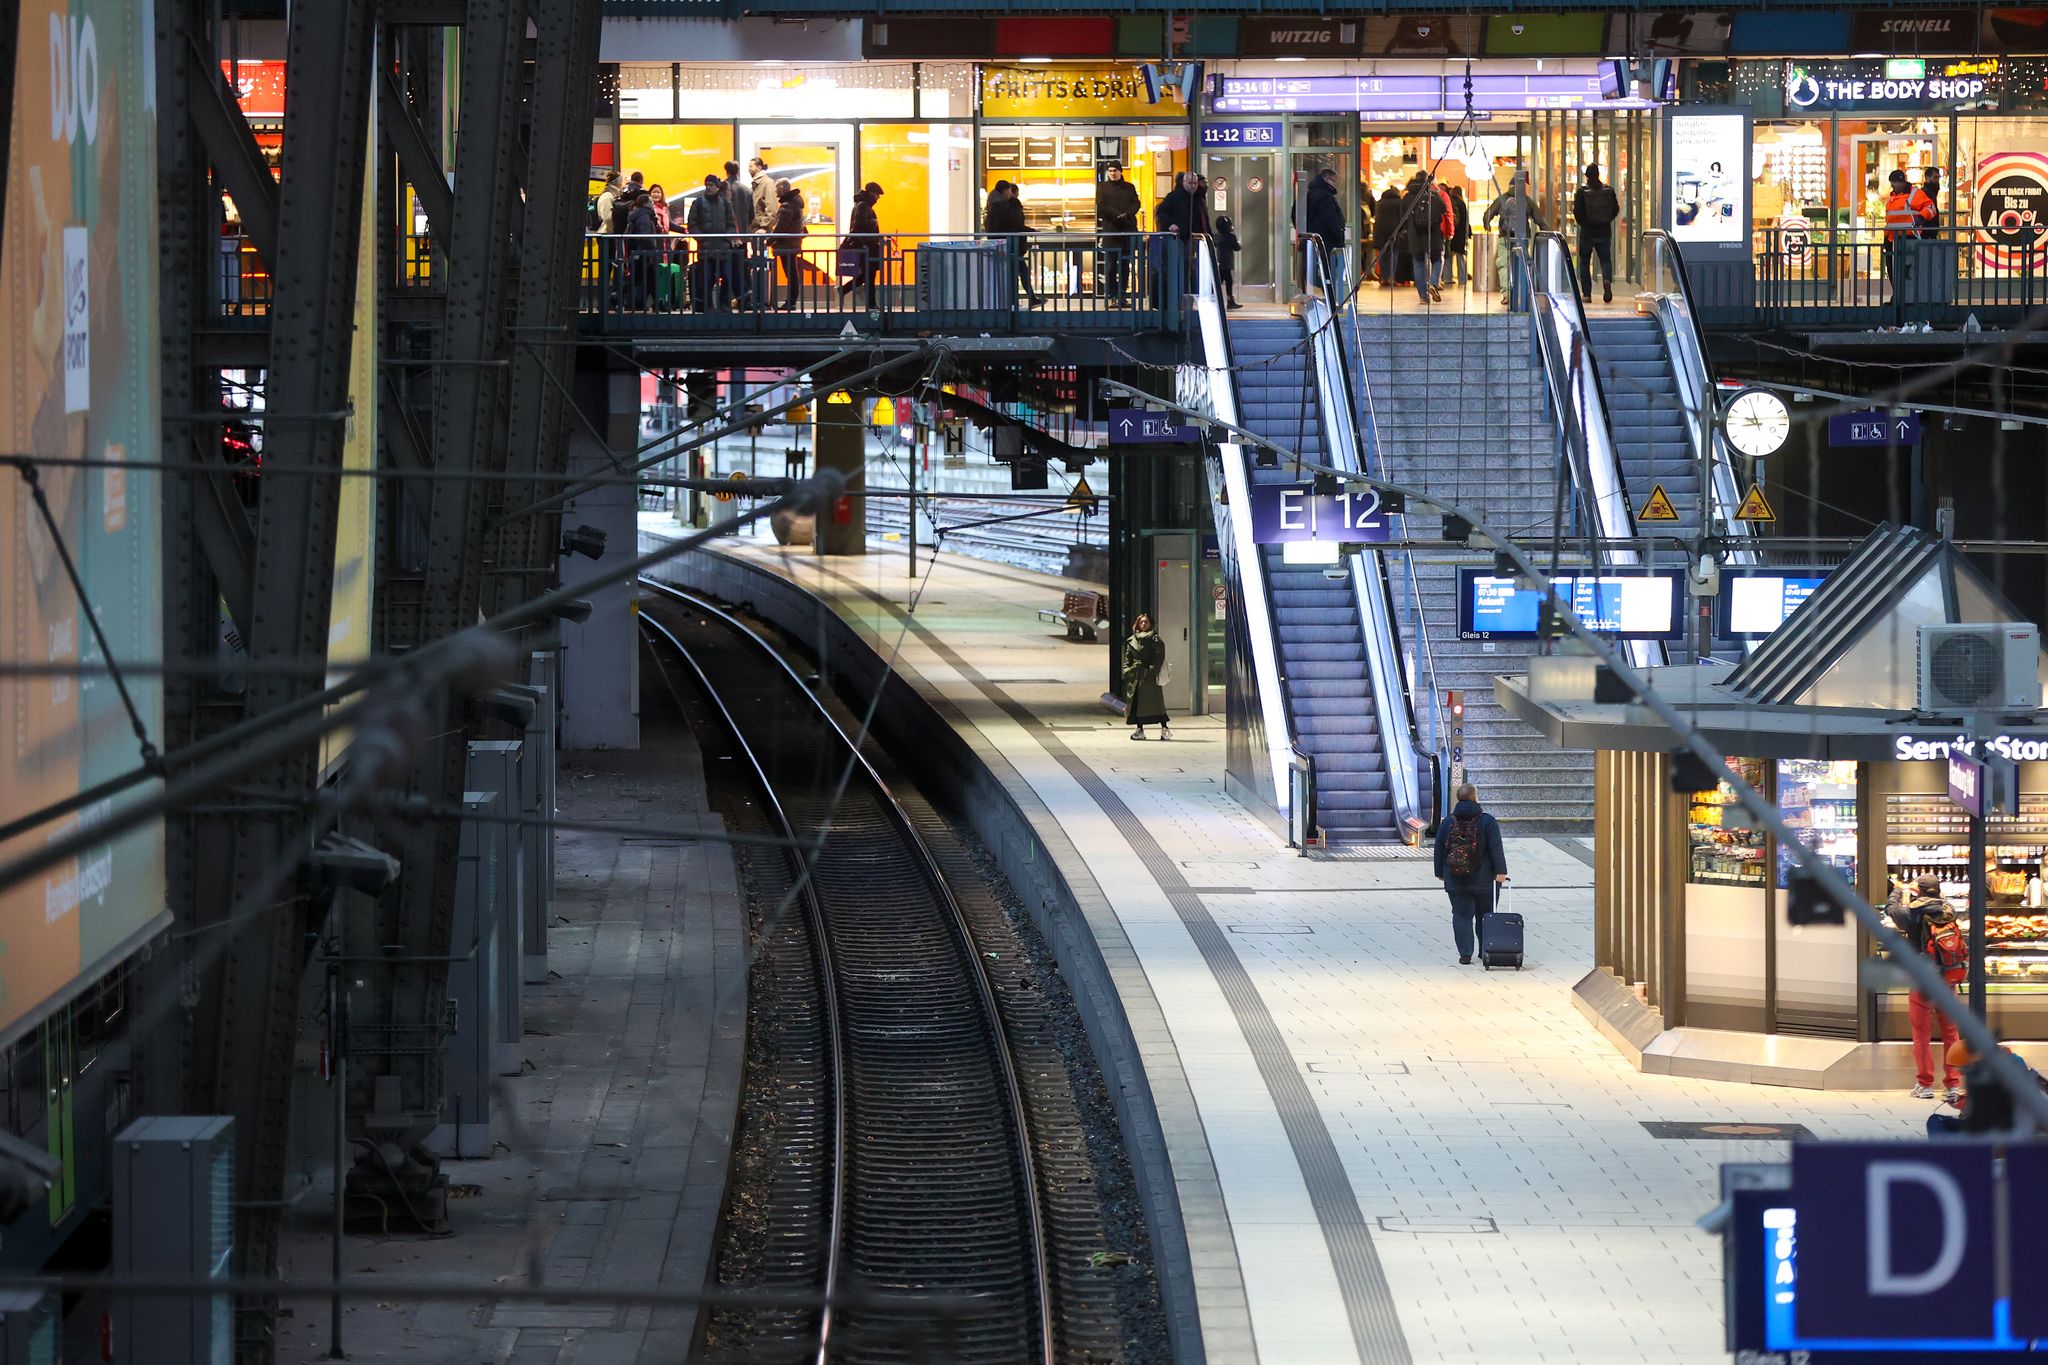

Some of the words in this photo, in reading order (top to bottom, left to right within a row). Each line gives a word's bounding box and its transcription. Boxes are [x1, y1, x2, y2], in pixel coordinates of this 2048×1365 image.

[1880, 19, 1952, 33] SCHNELL
[1271, 30, 1332, 43] WITZIG
[49, 12, 98, 146] DUO
[1072, 80, 1089, 99] &
[1227, 81, 1258, 93] 13-14
[1825, 81, 1865, 100] THE
[1870, 80, 1925, 100] BODY
[1929, 79, 1983, 99] SHOP
[1204, 128, 1240, 142] 11-12
[2008, 187, 2022, 196] BLACK
[2024, 187, 2043, 196] FRIDAY
[2004, 196, 2018, 209] Bis
[2019, 198, 2029, 209] zu
[1987, 210, 2045, 235] 40%
[1280, 489, 1306, 530] E
[1335, 488, 1380, 529] 12
[1461, 631, 1481, 639] Gleis
[1482, 631, 1490, 639] 12
[1866, 1160, 1968, 1296] D
